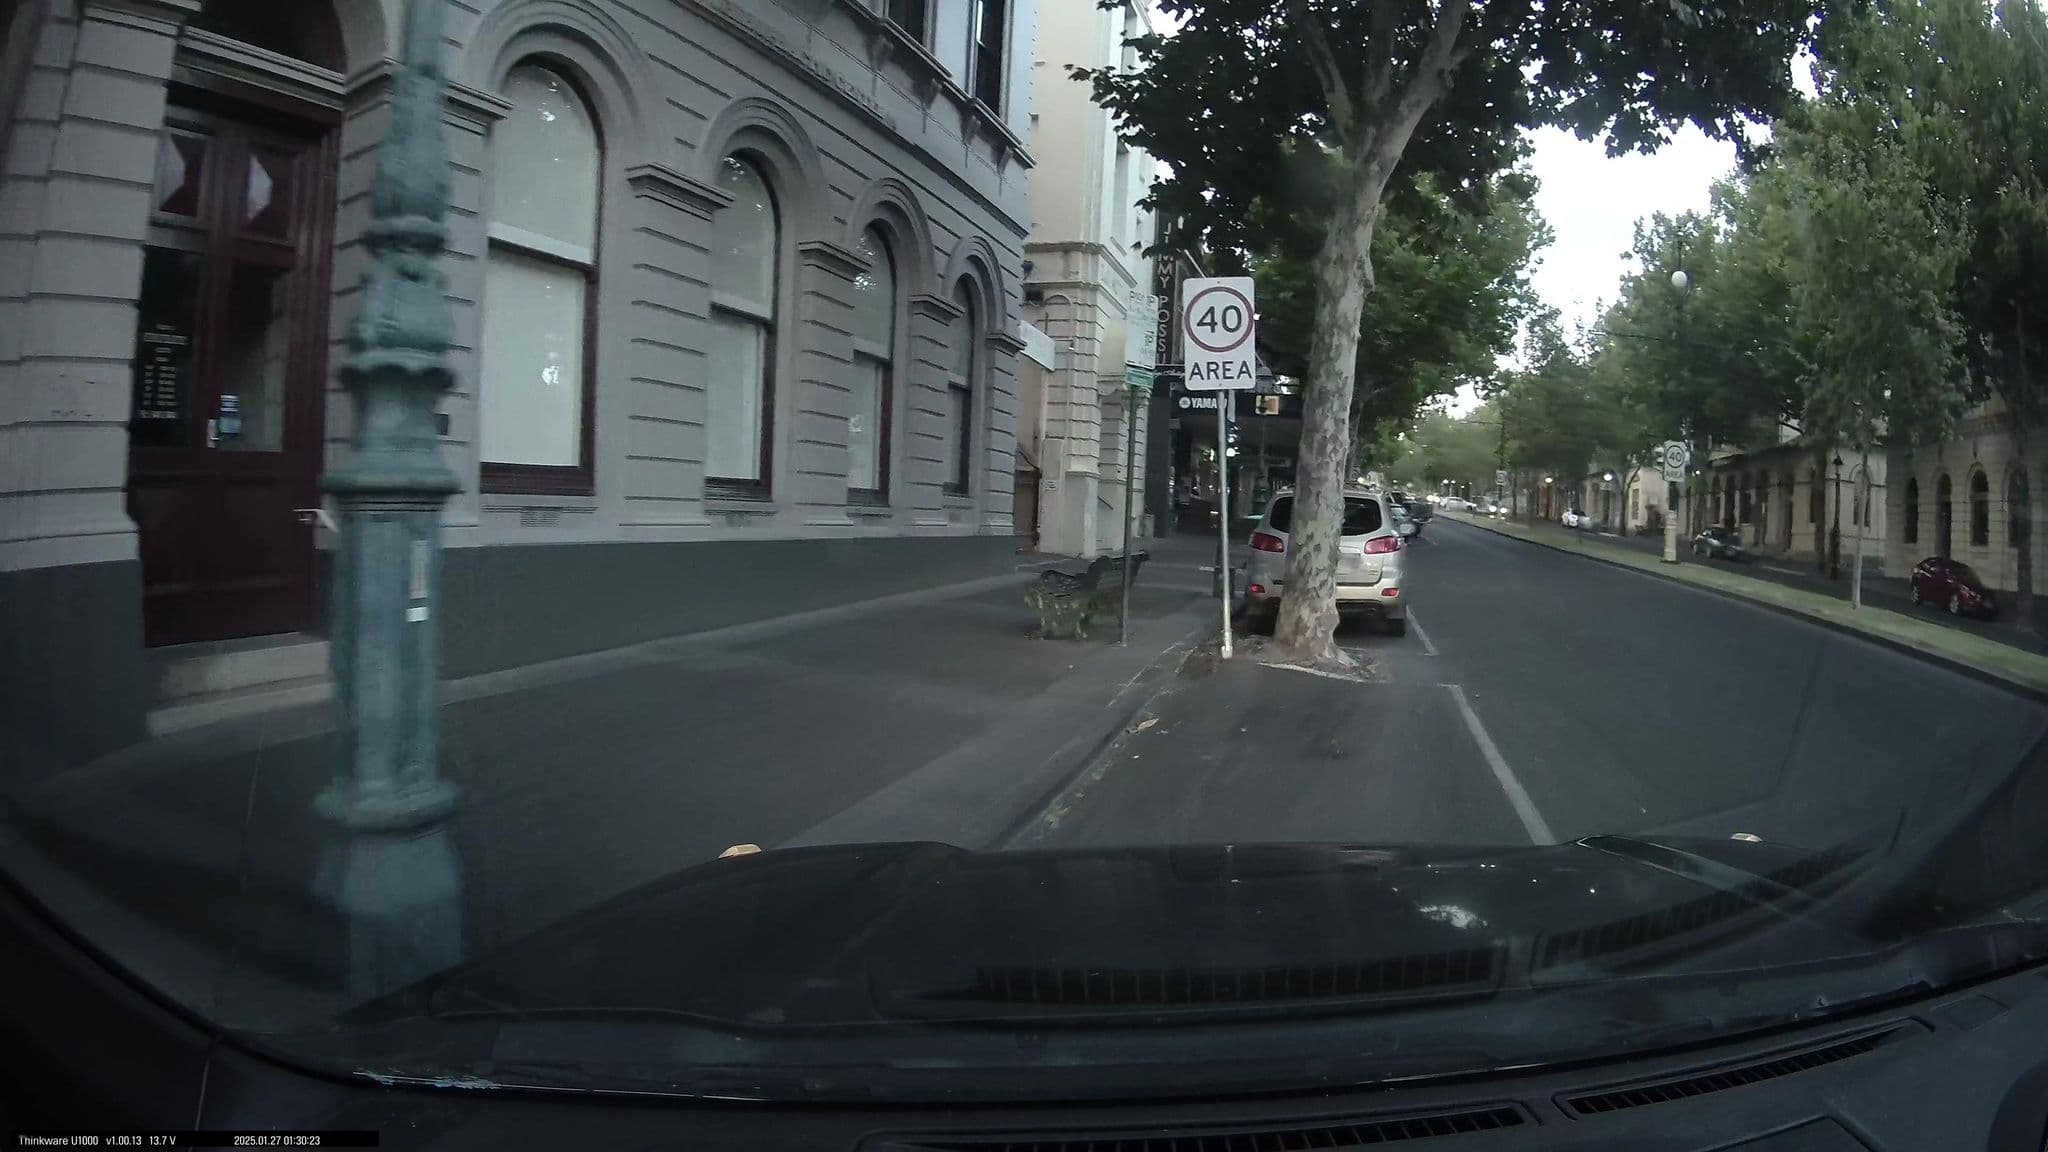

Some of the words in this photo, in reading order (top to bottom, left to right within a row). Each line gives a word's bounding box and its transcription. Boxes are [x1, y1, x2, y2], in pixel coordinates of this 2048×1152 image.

[1196, 304, 1242, 333] 40
[1188, 360, 1253, 381] AREA
[1191, 397, 1228, 409] YAMA
[1669, 452, 1682, 462] 40
